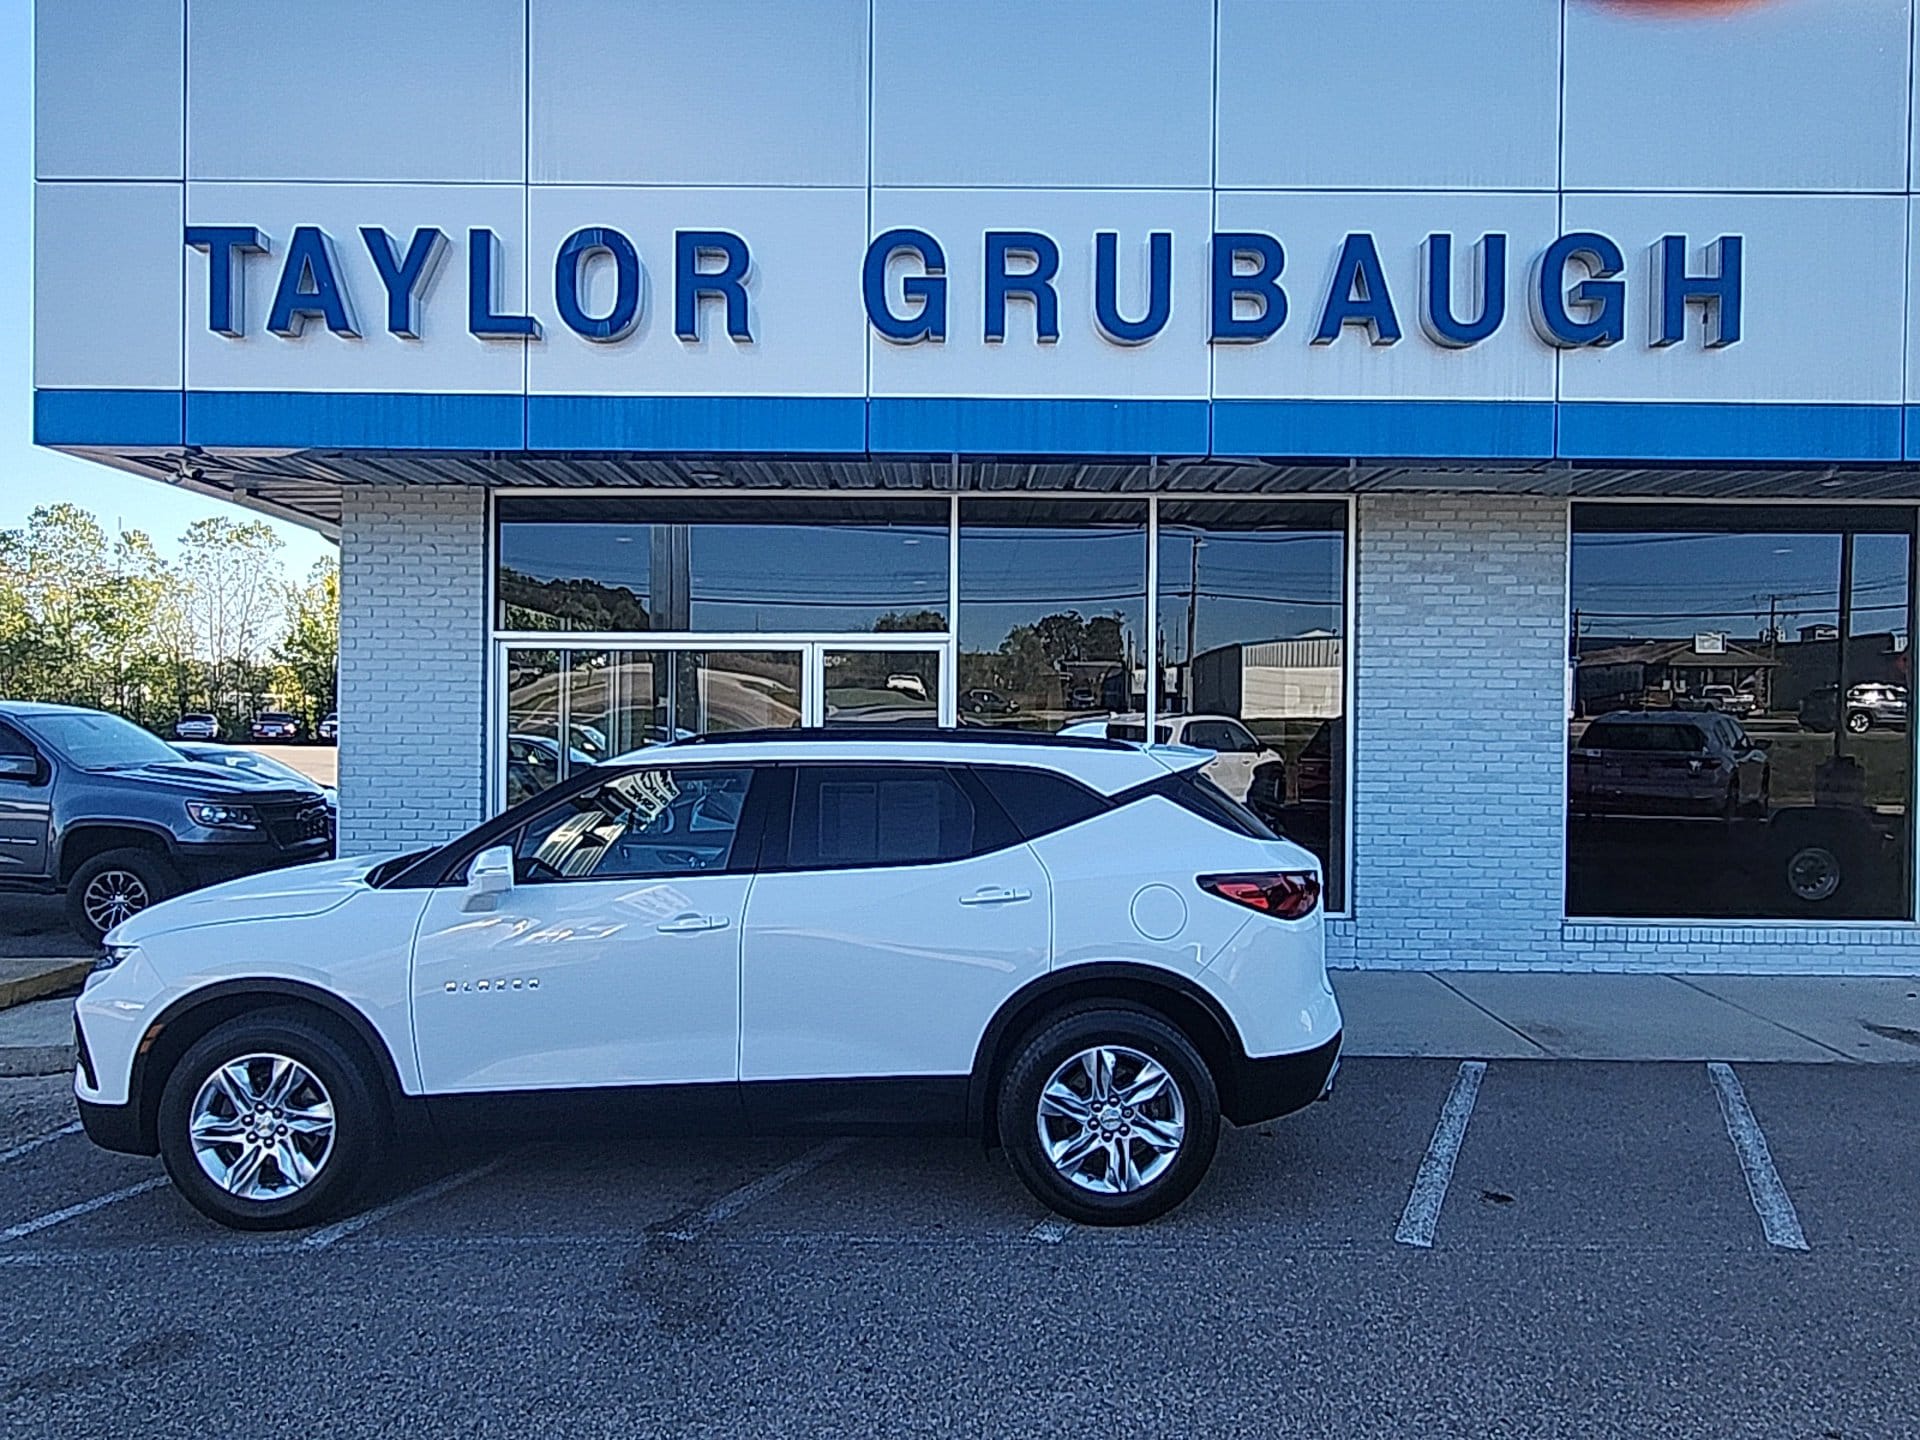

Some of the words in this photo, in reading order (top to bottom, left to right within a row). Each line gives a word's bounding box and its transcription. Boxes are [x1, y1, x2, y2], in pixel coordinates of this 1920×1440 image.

[185, 226, 755, 343] TAYLOR
[863, 229, 1743, 349] GRUBAUGH
[444, 977, 540, 992] BLAZER
